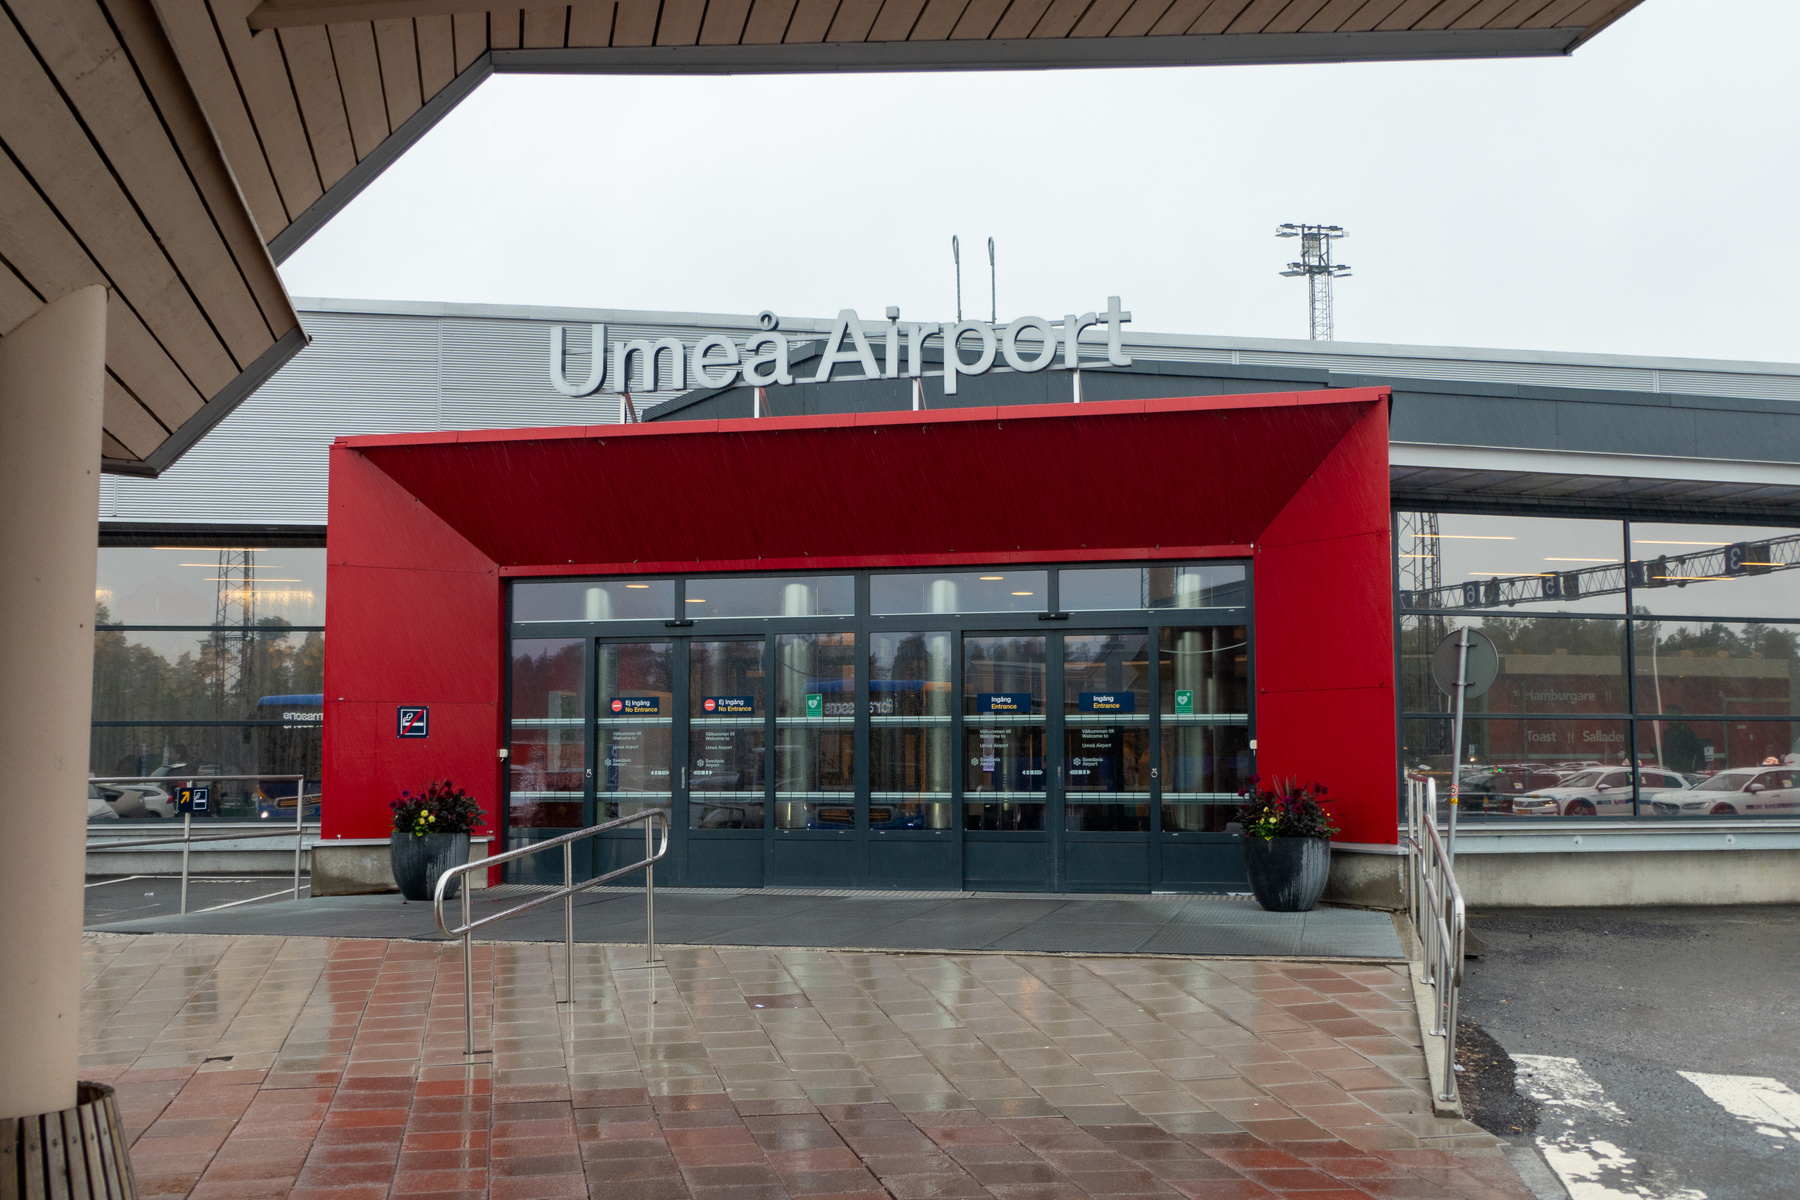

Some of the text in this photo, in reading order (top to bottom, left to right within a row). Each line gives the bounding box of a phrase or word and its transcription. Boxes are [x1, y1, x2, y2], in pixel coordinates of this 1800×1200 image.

[549, 295, 1133, 398] Umeå Airport
[991, 696, 1012, 704] Ingång
[1093, 695, 1114, 703] Ingång
[1525, 689, 1596, 704] Hamburgare
[1527, 730, 1557, 742] Toast
